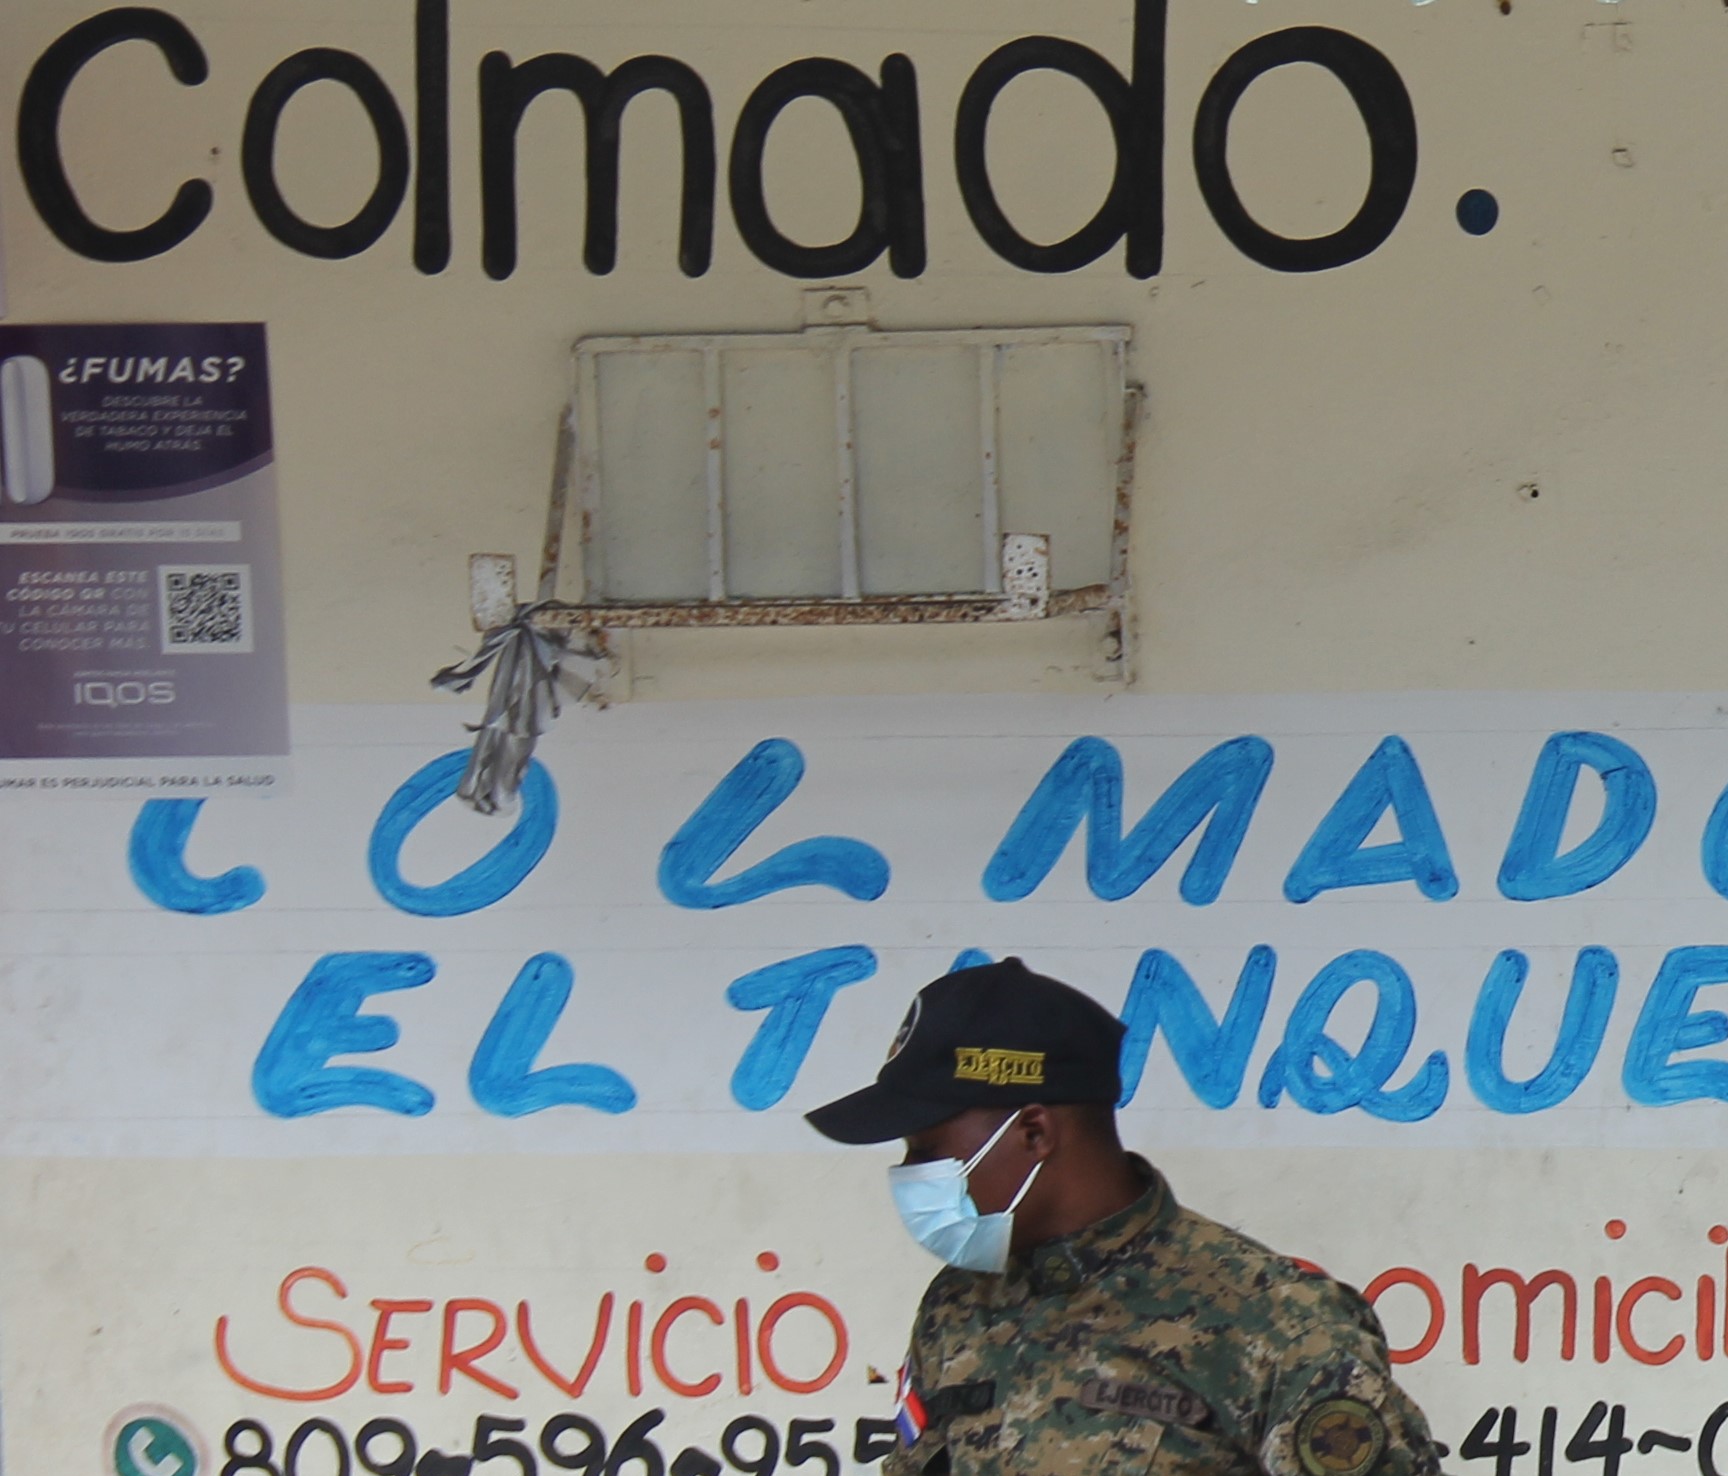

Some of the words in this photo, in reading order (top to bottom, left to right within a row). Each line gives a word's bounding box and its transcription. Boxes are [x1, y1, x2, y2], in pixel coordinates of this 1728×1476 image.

[57, 356, 247, 384] ¿FUMAS?
[18, 571, 99, 585] ESCANEA
[104, 570, 149, 584] ESTE
[73, 681, 177, 709] IQOS
[62, 775, 156, 788] PERJUDICIAL
[159, 774, 198, 788] PARA
[203, 775, 223, 787] LA
[227, 774, 275, 786] SALUD
[252, 952, 638, 1119] EL
